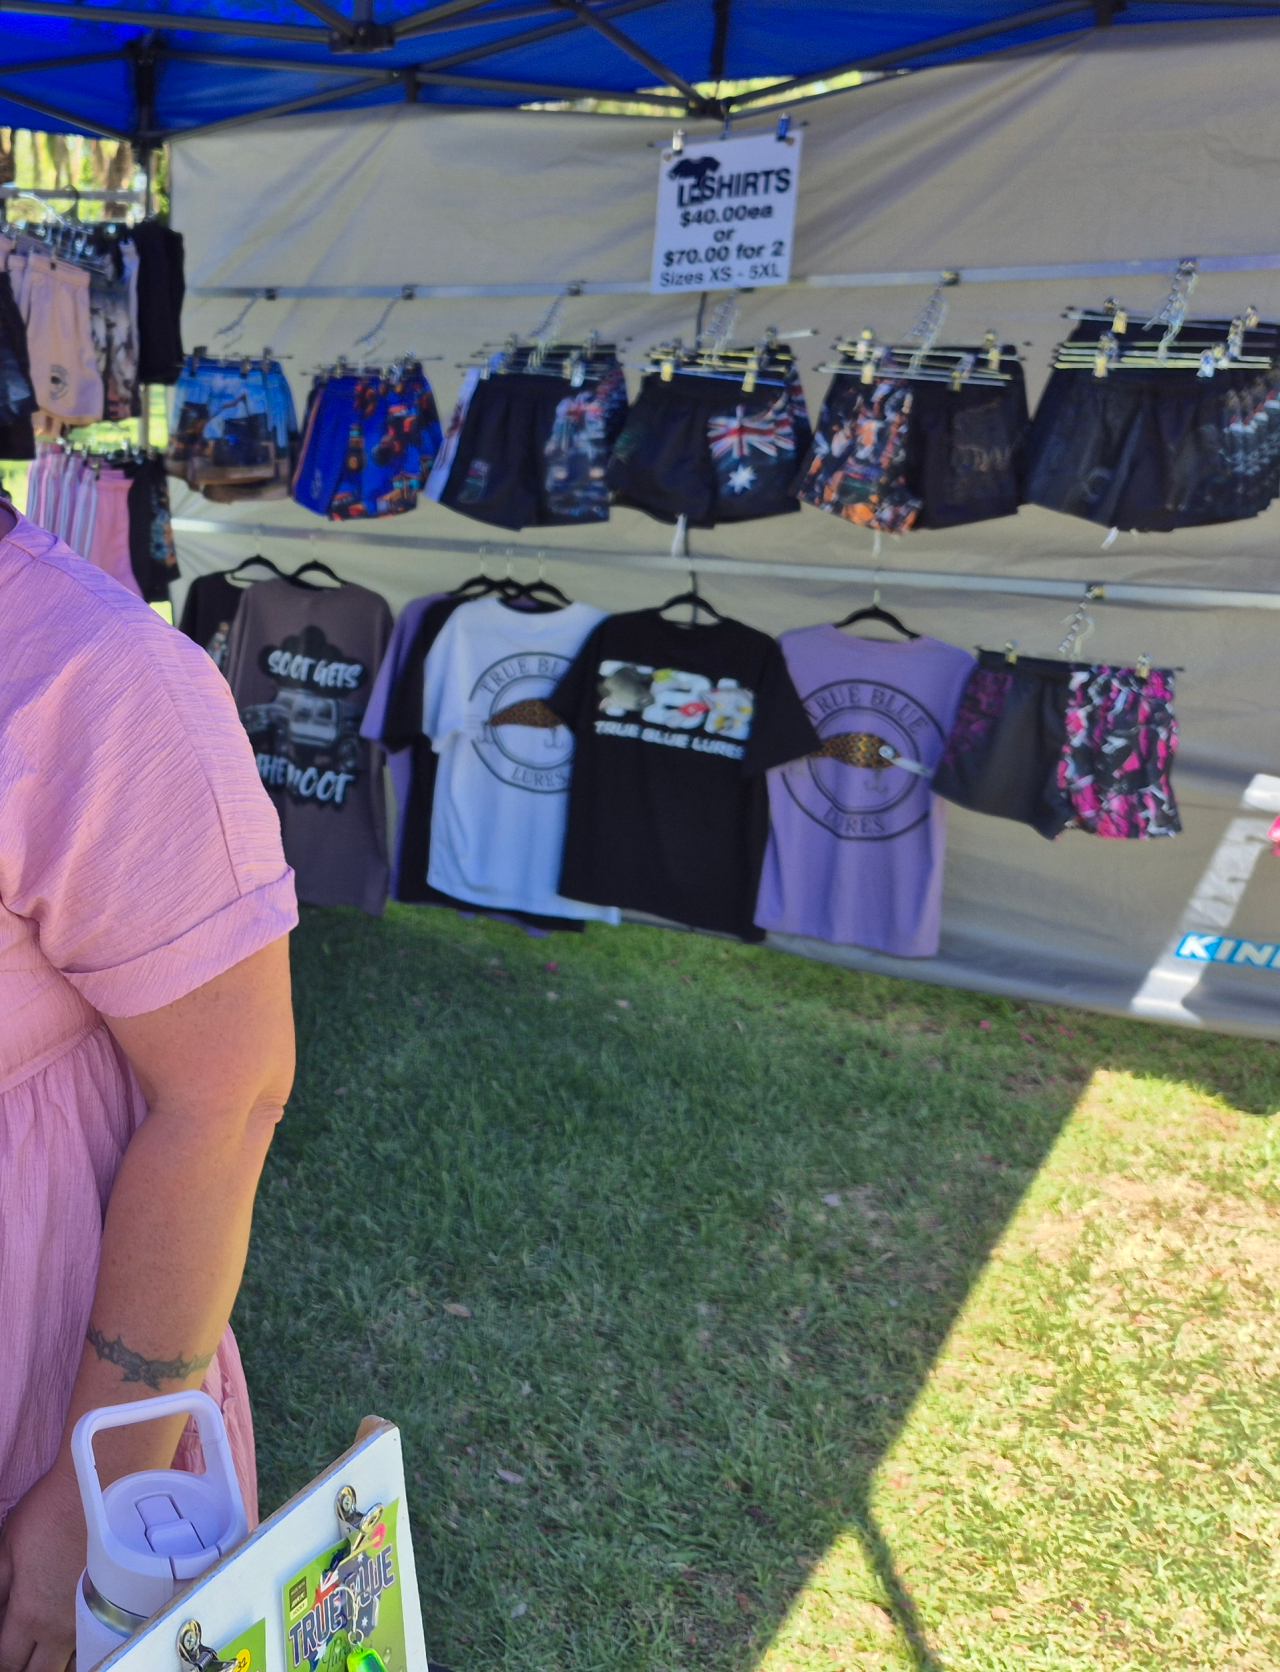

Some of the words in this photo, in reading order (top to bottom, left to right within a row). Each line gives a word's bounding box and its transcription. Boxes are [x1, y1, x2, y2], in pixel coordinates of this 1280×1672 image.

[680, 205, 774, 228] $40.00ea
[713, 228, 734, 243] or
[663, 245, 730, 268] $70.00
[736, 242, 765, 260] for
[771, 240, 785, 258] 2
[659, 270, 704, 288] Sizes
[710, 266, 732, 283] XS
[749, 263, 783, 280] 5XL
[313, 659, 365, 690] GETS
[481, 658, 530, 695] TRUE
[871, 688, 929, 734] BLUE
[594, 720, 641, 739] TRUE
[641, 727, 692, 749] BLUE
[1176, 934, 1280, 970] KIN
[289, 1591, 343, 1668] TRUE
